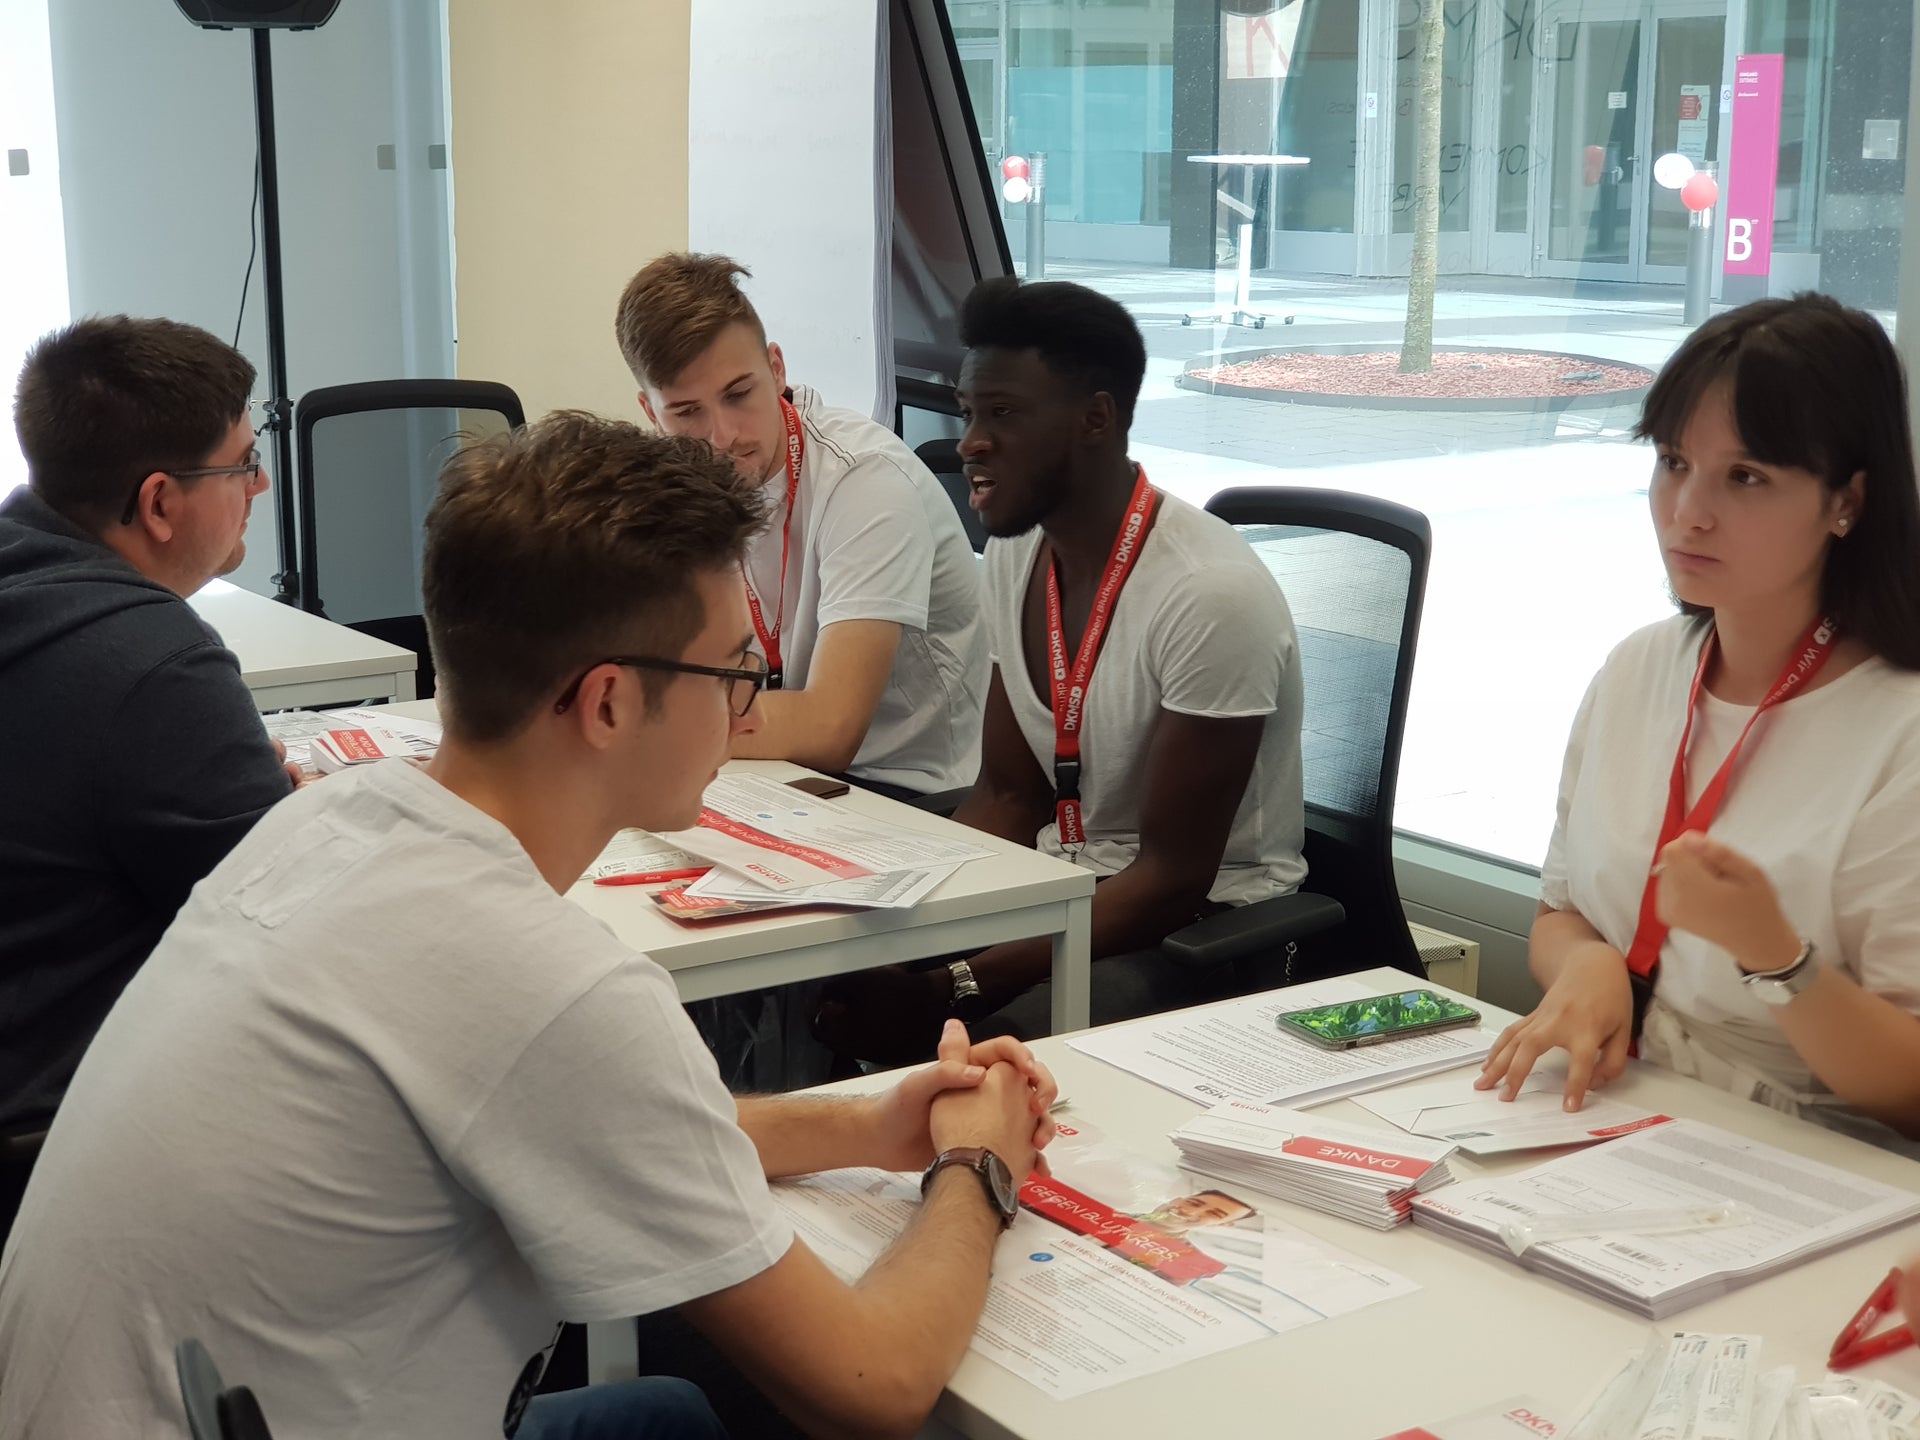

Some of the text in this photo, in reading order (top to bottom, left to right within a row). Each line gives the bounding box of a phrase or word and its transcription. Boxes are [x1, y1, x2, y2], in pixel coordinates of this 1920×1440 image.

[1727, 218, 1752, 261] B
[789, 444, 802, 480] DKMS
[1115, 524, 1140, 563] DKMS
[1096, 563, 1124, 613] Blutkrebs
[1051, 630, 1065, 668] DKMS
[1080, 615, 1103, 663] besiegen
[1075, 663, 1087, 682] Wir
[1797, 648, 1820, 673] Wir
[1064, 697, 1081, 731] DKMS
[1065, 813, 1079, 843] DKMS
[1317, 1145, 1403, 1169] DANKE
[1029, 1185, 1088, 1215] GEGEN
